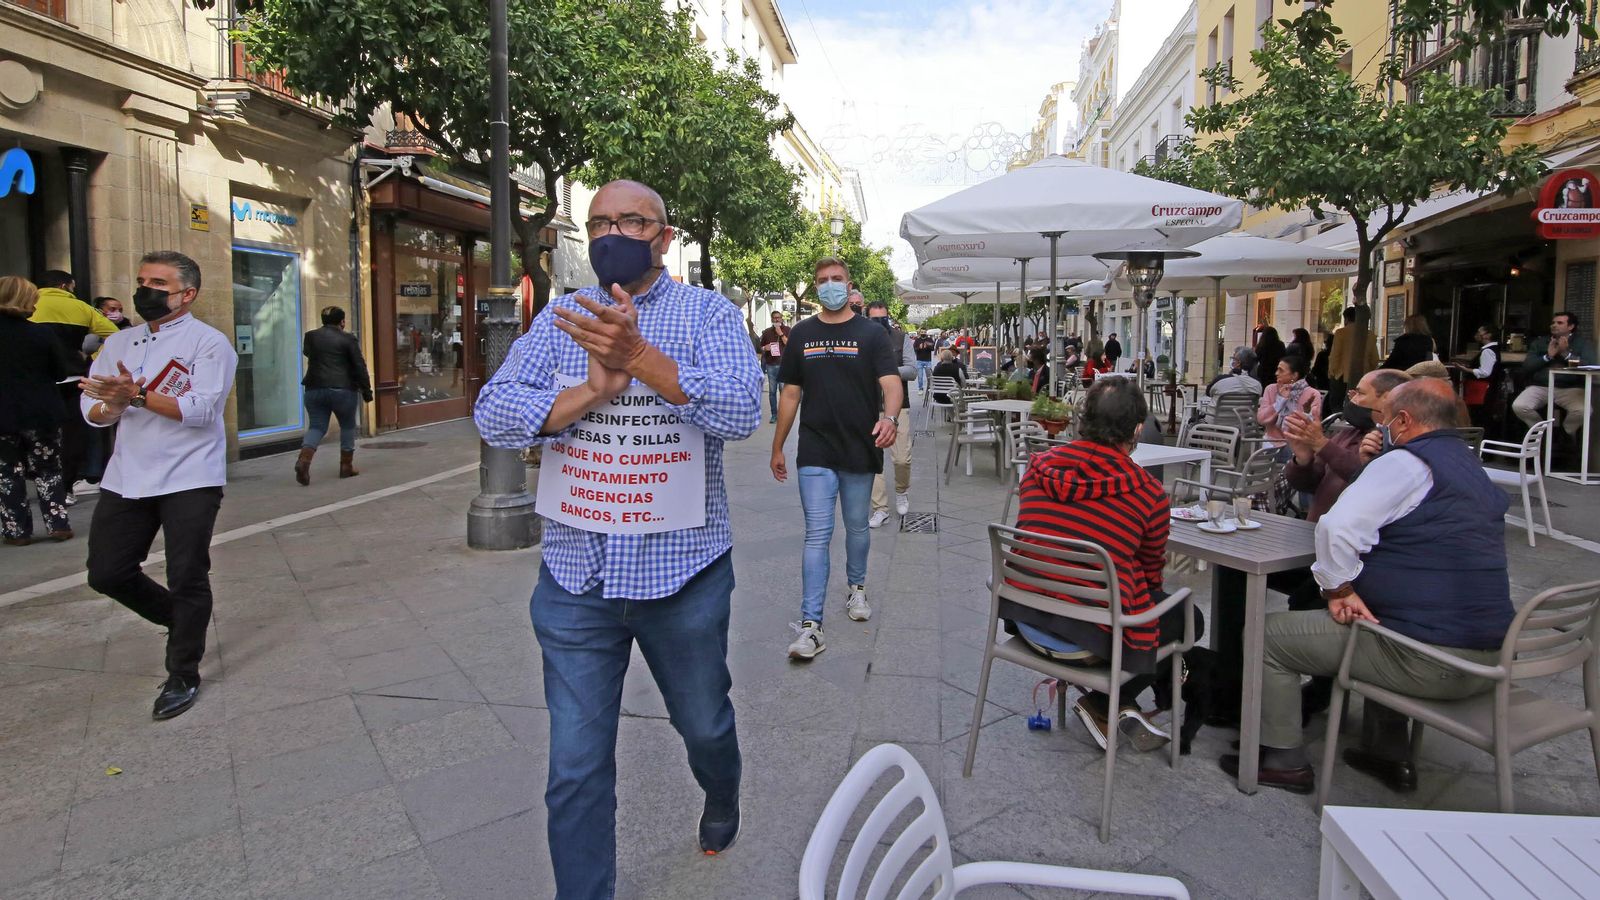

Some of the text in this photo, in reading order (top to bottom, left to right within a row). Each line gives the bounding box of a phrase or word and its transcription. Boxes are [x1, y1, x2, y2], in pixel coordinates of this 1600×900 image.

[1151, 204, 1223, 218] Cruzcampo
[1306, 257, 1358, 267] Cruzcampo
[403, 283, 428, 297] rebajas
[804, 340, 858, 348] QUIKSILVER
[616, 434, 627, 446] Y
[632, 432, 681, 446] SILLAS
[551, 441, 692, 466] LOS QUE NO CUMPLEN:
[561, 463, 669, 485] AYUNTAMIENTO
[570, 485, 654, 504] URGENCIAS
[560, 501, 665, 525] BANCOS, ETC...
